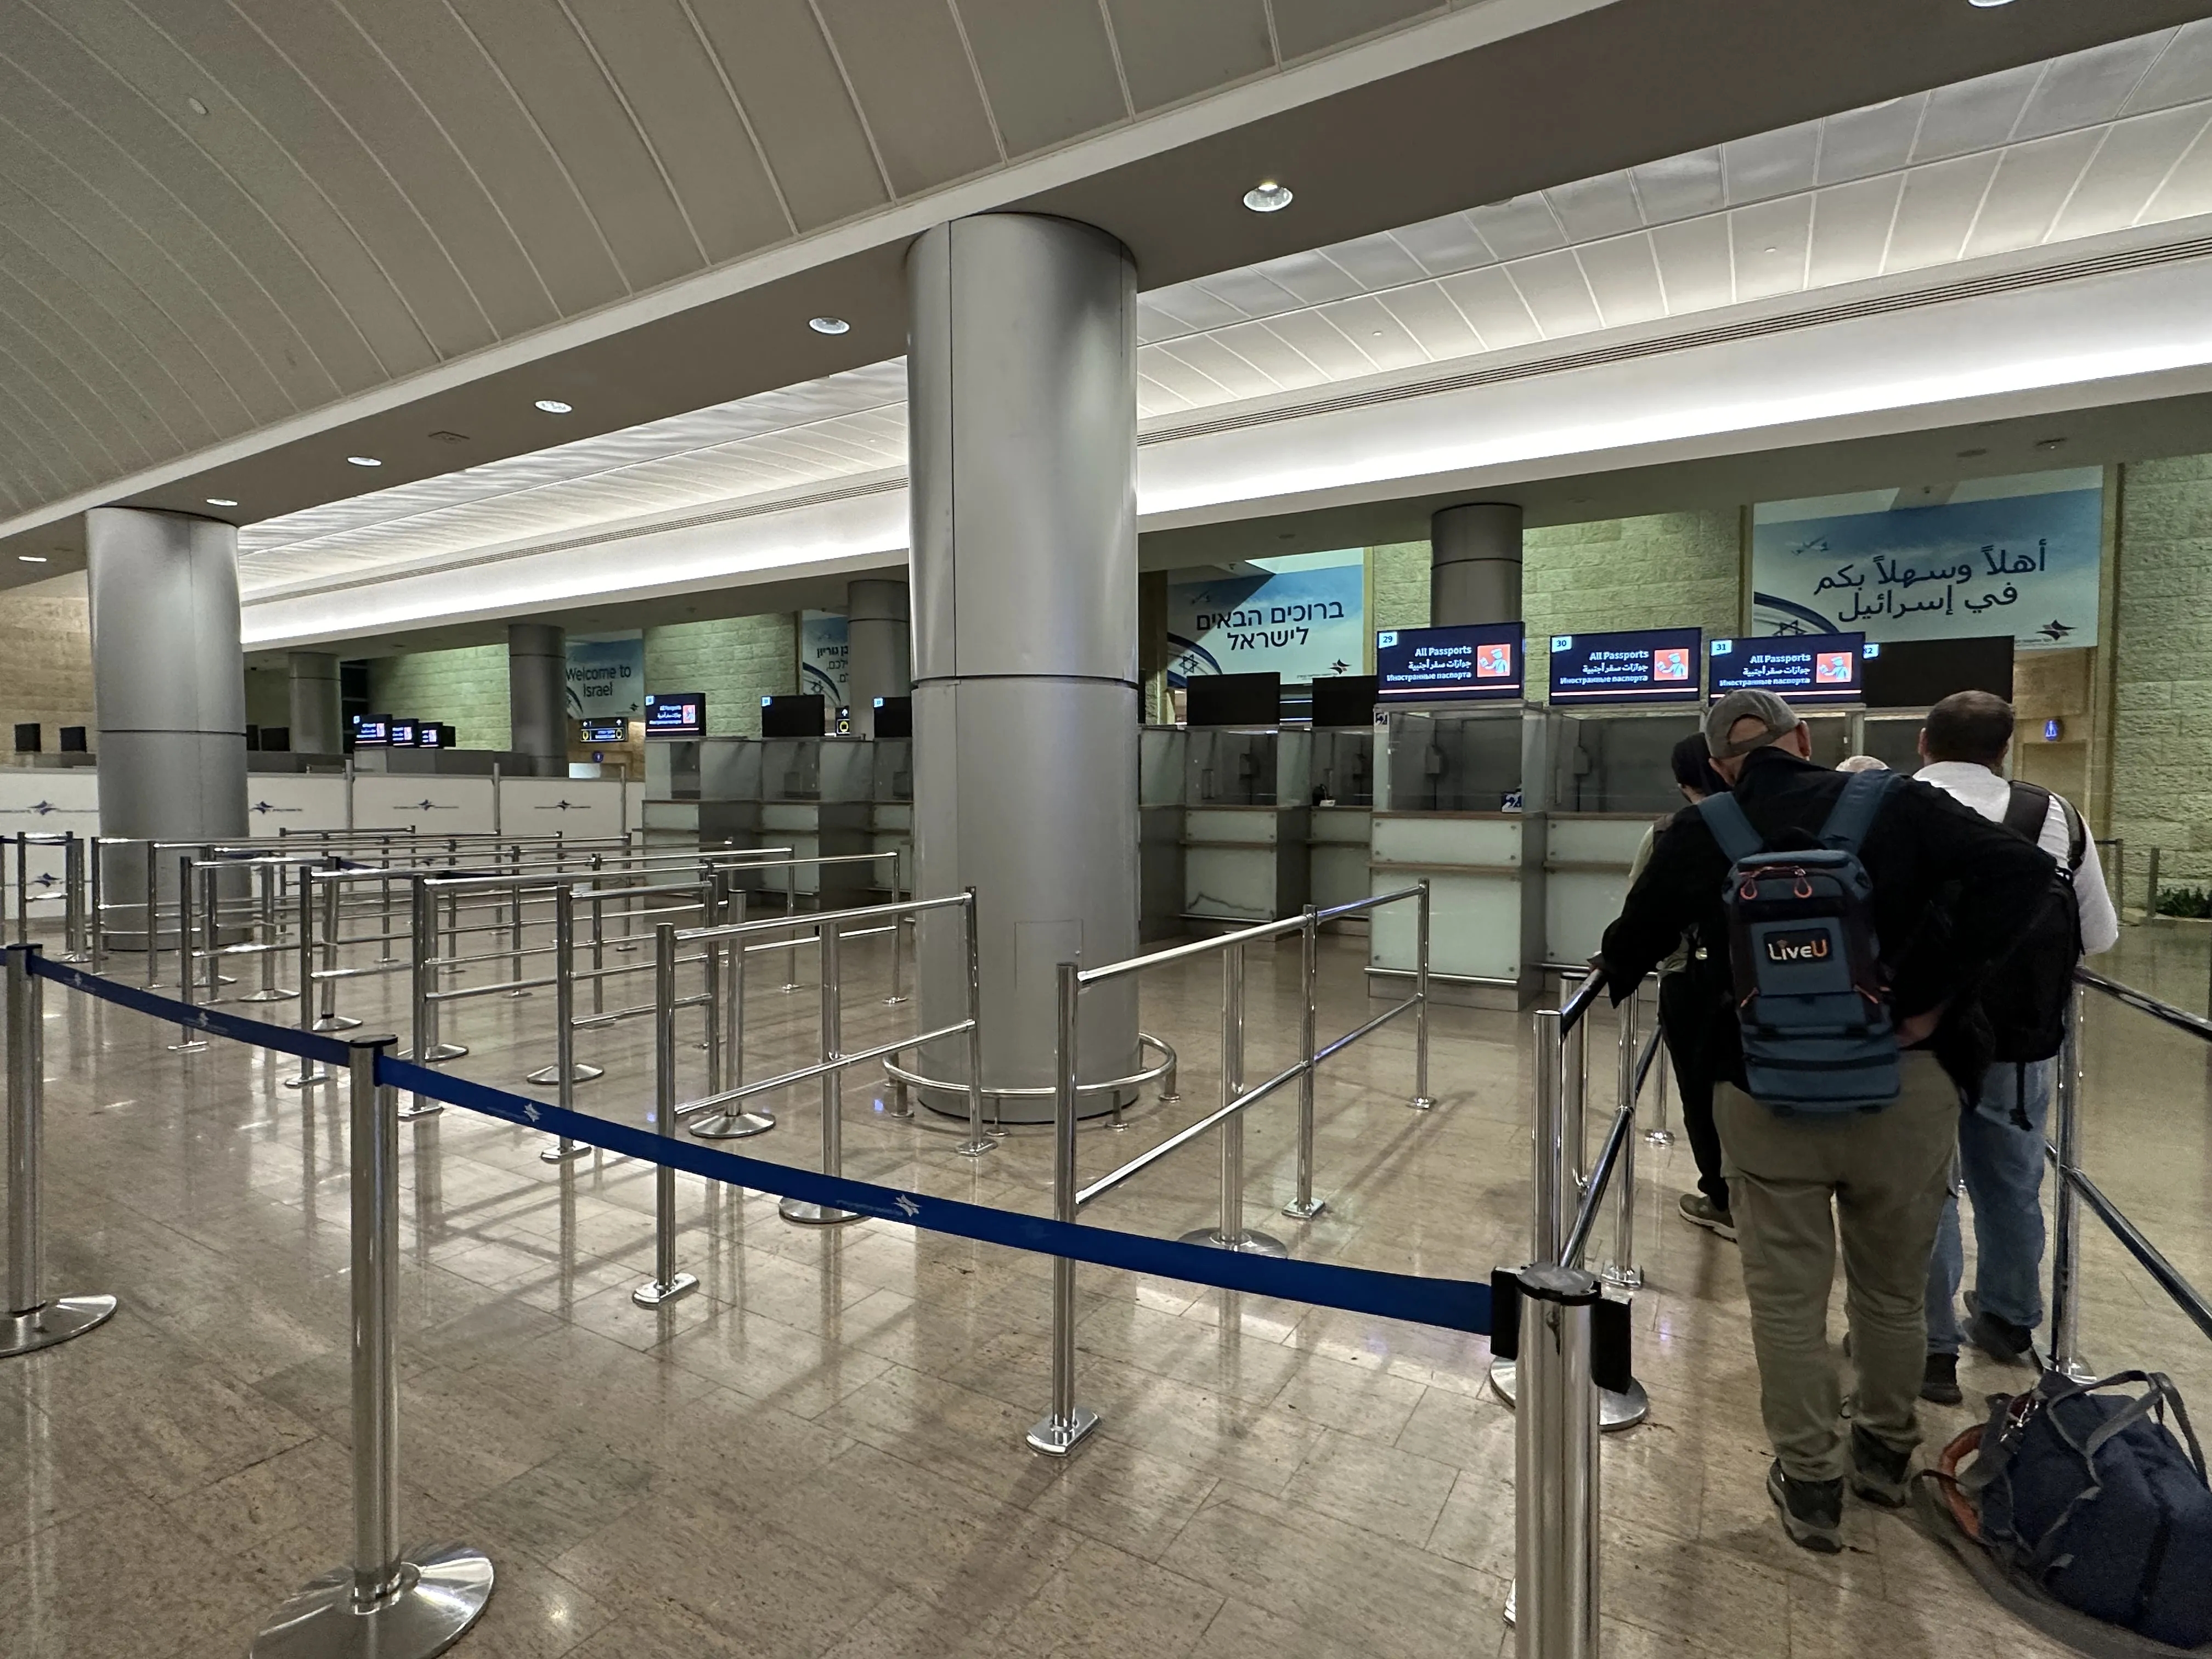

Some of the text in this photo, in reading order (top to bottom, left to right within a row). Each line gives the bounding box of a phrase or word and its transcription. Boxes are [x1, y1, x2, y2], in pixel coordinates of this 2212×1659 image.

[1814, 564, 1865, 596] بكم
[1838, 582, 2018, 623] في إسرائيل
[1197, 601, 1344, 631] ברוכים הבאים
[1227, 627, 1309, 651] לישראל
[1415, 646, 1471, 657] All Passports
[1589, 650, 1649, 661] All Passports
[1750, 653, 1811, 664] All Passports
[566, 664, 631, 681] Welcome to
[1447, 659, 1471, 669] جوازات
[583, 681, 613, 697] Israel
[1768, 939, 1827, 960] LiveU
